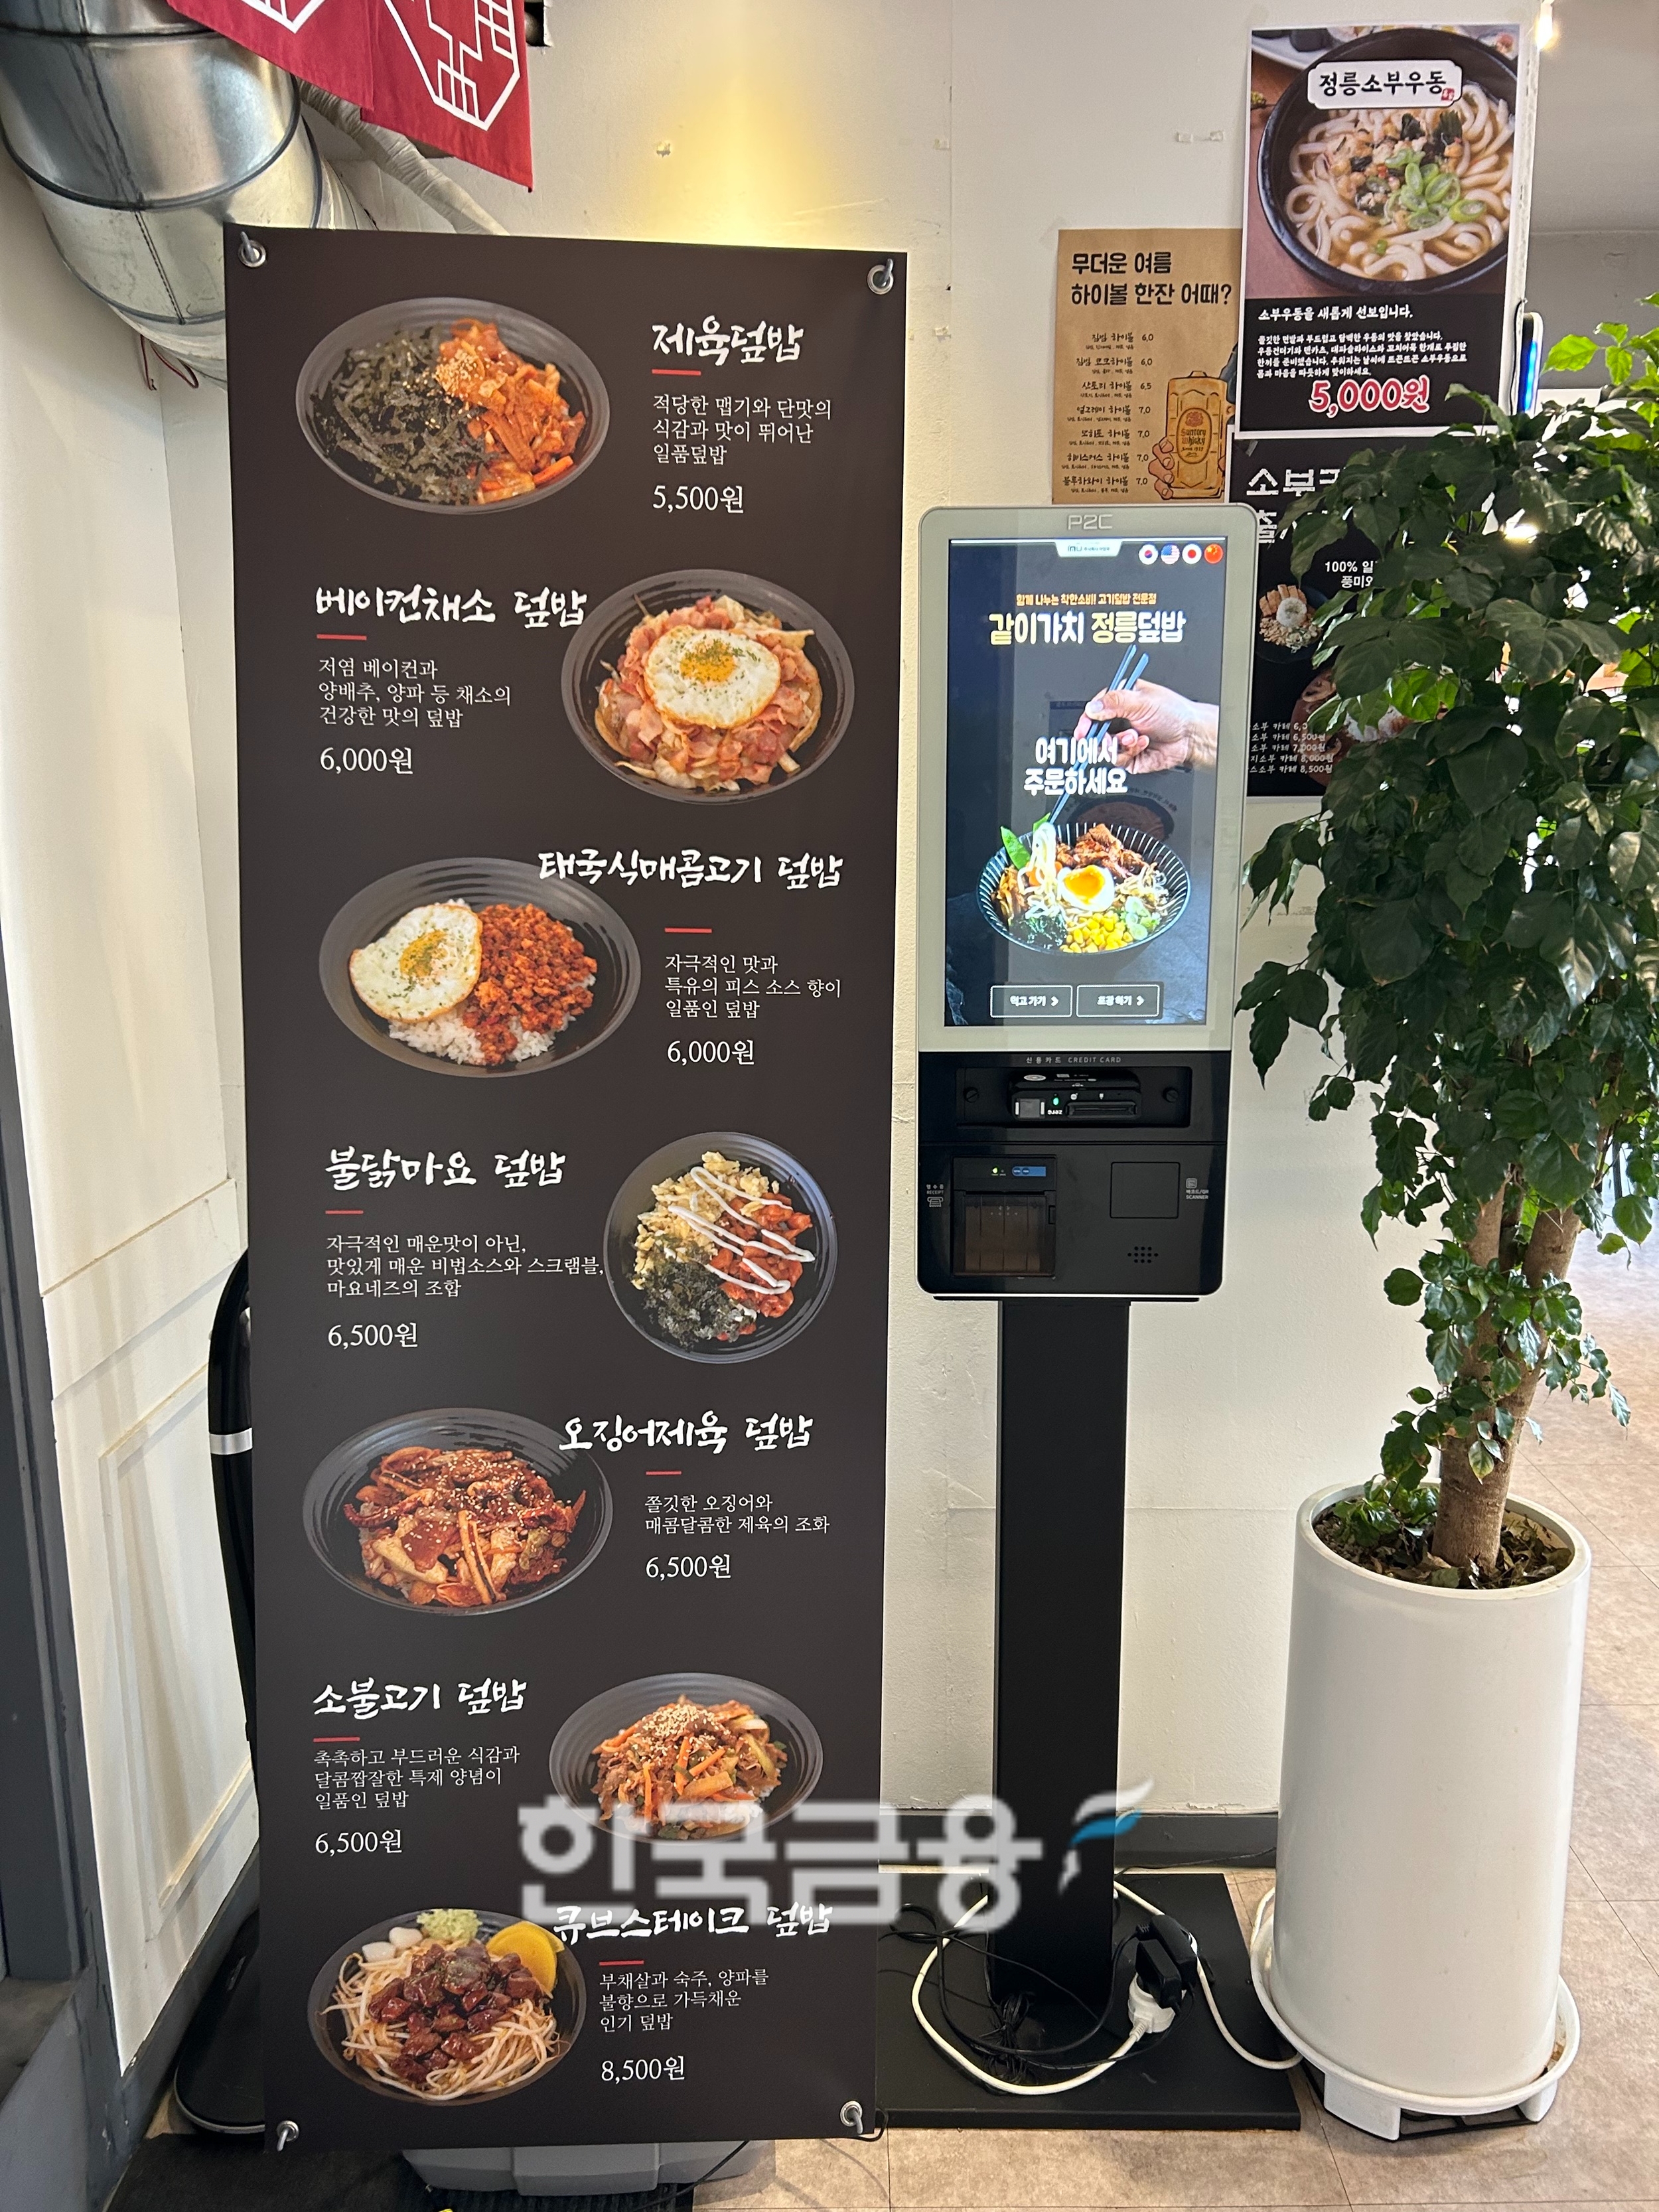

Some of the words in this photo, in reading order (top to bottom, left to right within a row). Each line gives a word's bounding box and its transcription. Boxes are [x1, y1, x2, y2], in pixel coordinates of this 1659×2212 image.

[1319, 71, 1447, 98] 정릉소부우동
[1072, 252, 1127, 275] 무더운
[1135, 252, 1171, 273] 여름
[1072, 283, 1127, 305] 하이볼
[1135, 283, 1175, 305] 한잔
[1181, 283, 1231, 305] 어때?
[1258, 307, 1314, 321] 소부우동을
[1317, 306, 1352, 320] 새롭게
[1356, 304, 1413, 319] 선보입니다.
[652, 315, 804, 366] 제육덮밥
[1111, 332, 1133, 342] 하이볼
[1283, 334, 1304, 344] 면발과
[1306, 334, 1336, 343] 부드럽고
[1363, 332, 1385, 342] 우동의
[1388, 332, 1402, 342] 맛을
[1404, 331, 1443, 341] 찾았습니다.
[1258, 346, 1301, 356] 우동건더기와
[1331, 342, 1384, 354] 대파슬라이스와
[1445, 342, 1467, 352] 푸짐한
[1258, 358, 1279, 367] 한끼를
[1282, 356, 1328, 366] 준비했습니다.
[1331, 356, 1360, 365] 추워지는
[1363, 355, 1385, 364] 날씨에
[1421, 354, 1467, 363] 소부우동으로
[1275, 368, 1296, 378] 마음을
[1299, 368, 1329, 377] 따뜻하게
[1332, 366, 1371, 376] 맞이하세요.
[1110, 381, 1131, 391] 하이볼
[1308, 374, 1430, 418] 5,000원
[654, 394, 708, 415] 적당한
[715, 396, 770, 418] 맵기와
[777, 398, 830, 420] 단맛의
[1109, 405, 1131, 415] 하이볼
[653, 419, 708, 440] 식감과
[715, 421, 749, 442] 맛이
[758, 423, 813, 443] 뛰어난
[1108, 429, 1129, 439] 하이볼
[654, 443, 727, 465] 일품덮밥
[1107, 453, 1129, 463] 하이볼
[1106, 477, 1128, 486] 하이볼
[653, 486, 743, 513] 5,500원
[1068, 514, 1113, 530] P2C
[1325, 561, 1358, 573] 100%
[317, 584, 495, 623] 베이컨채소
[514, 587, 587, 628] 덮밥
[1036, 593, 1058, 605] 나누는
[1061, 593, 1096, 605] 착한소비!
[1098, 593, 1130, 605] 고기덮밥
[1132, 593, 1157, 605] 전문점
[988, 610, 1084, 645] 같이가치
[1091, 610, 1187, 644] 정릉덮밥
[320, 657, 353, 676] 저염
[363, 658, 438, 680] 베이컨과
[319, 681, 380, 701] 양배추,
[388, 683, 425, 703] 양파
[431, 686, 449, 704] 등
[457, 686, 510, 705] 채소의
[321, 705, 376, 725] 건강한
[383, 707, 417, 727] 맛의
[427, 708, 463, 727] 덮밥
[1273, 733, 1290, 741] 카레
[1293, 733, 1326, 742] 6,500원
[1293, 743, 1326, 753] 7,000원
[321, 747, 413, 774] 6,000원
[1035, 737, 1118, 765] 여기에서
[1280, 754, 1297, 763] 카레
[1301, 754, 1334, 763] 8,000원
[1300, 765, 1333, 774] 8,500원
[1024, 767, 1128, 796] 주문하세요
[538, 849, 761, 890] 태국식매콤고기
[778, 853, 843, 889] 덮밥
[666, 954, 735, 973] 자극적인
[743, 956, 778, 974] 맛과
[665, 978, 717, 995] 특유의
[726, 978, 759, 996] 피스
[766, 980, 800, 994] 소스
[807, 979, 839, 997] 향이
[666, 999, 717, 1017] 일품인
[725, 1000, 760, 1018] 덮밥
[668, 1040, 754, 1065] 6,000원
[326, 1146, 476, 1190] 불닭마요
[495, 1150, 565, 1188] 덮밥
[327, 1235, 399, 1253] 자극적인
[407, 1235, 477, 1253] 매운맛이
[486, 1235, 526, 1253] 아닌,
[327, 1258, 380, 1276] 맛있게
[389, 1258, 425, 1275] 매운
[432, 1257, 522, 1275] 비법소스와
[528, 1257, 604, 1275] 스크램블,
[328, 1280, 417, 1297] 마요네즈의
[425, 1280, 461, 1297] 조합
[328, 1323, 417, 1349] 6,500원
[559, 1411, 727, 1453] 오징어제육
[746, 1413, 813, 1451] 덮밥
[645, 1495, 697, 1512] 쫄깃한
[703, 1495, 772, 1512] 오징어와
[646, 1516, 732, 1534] 매콤달콤한
[739, 1516, 788, 1533] 제육의
[796, 1516, 830, 1533] 조화
[646, 1554, 731, 1580] 6,500원
[313, 1677, 440, 1720] 소불고기
[459, 1678, 526, 1715] 덮밥
[315, 1749, 385, 1767] 촉촉하고
[392, 1747, 461, 1765] 부드러운
[469, 1746, 520, 1763] 식감과
[315, 1770, 403, 1789] 달콤짭잘한
[409, 1769, 442, 1786] 특제
[451, 1768, 500, 1785] 양념이
[316, 1792, 366, 1810] 일품인
[375, 1791, 409, 1808] 덮밥
[316, 1830, 401, 1856] 6,500원
[553, 1905, 749, 1945] 큐브스테이크
[766, 1902, 833, 1937] 덮밥
[600, 1972, 668, 1990] 부채살과
[674, 1971, 711, 1987] 숙주,
[719, 1969, 768, 1986] 양파를
[600, 1994, 667, 2011] 불향으로
[674, 1990, 741, 2008] 가득채운
[601, 2015, 631, 2032] 인기
[641, 2013, 673, 2031] 덮밥
[602, 2056, 684, 2084] 8,500원
